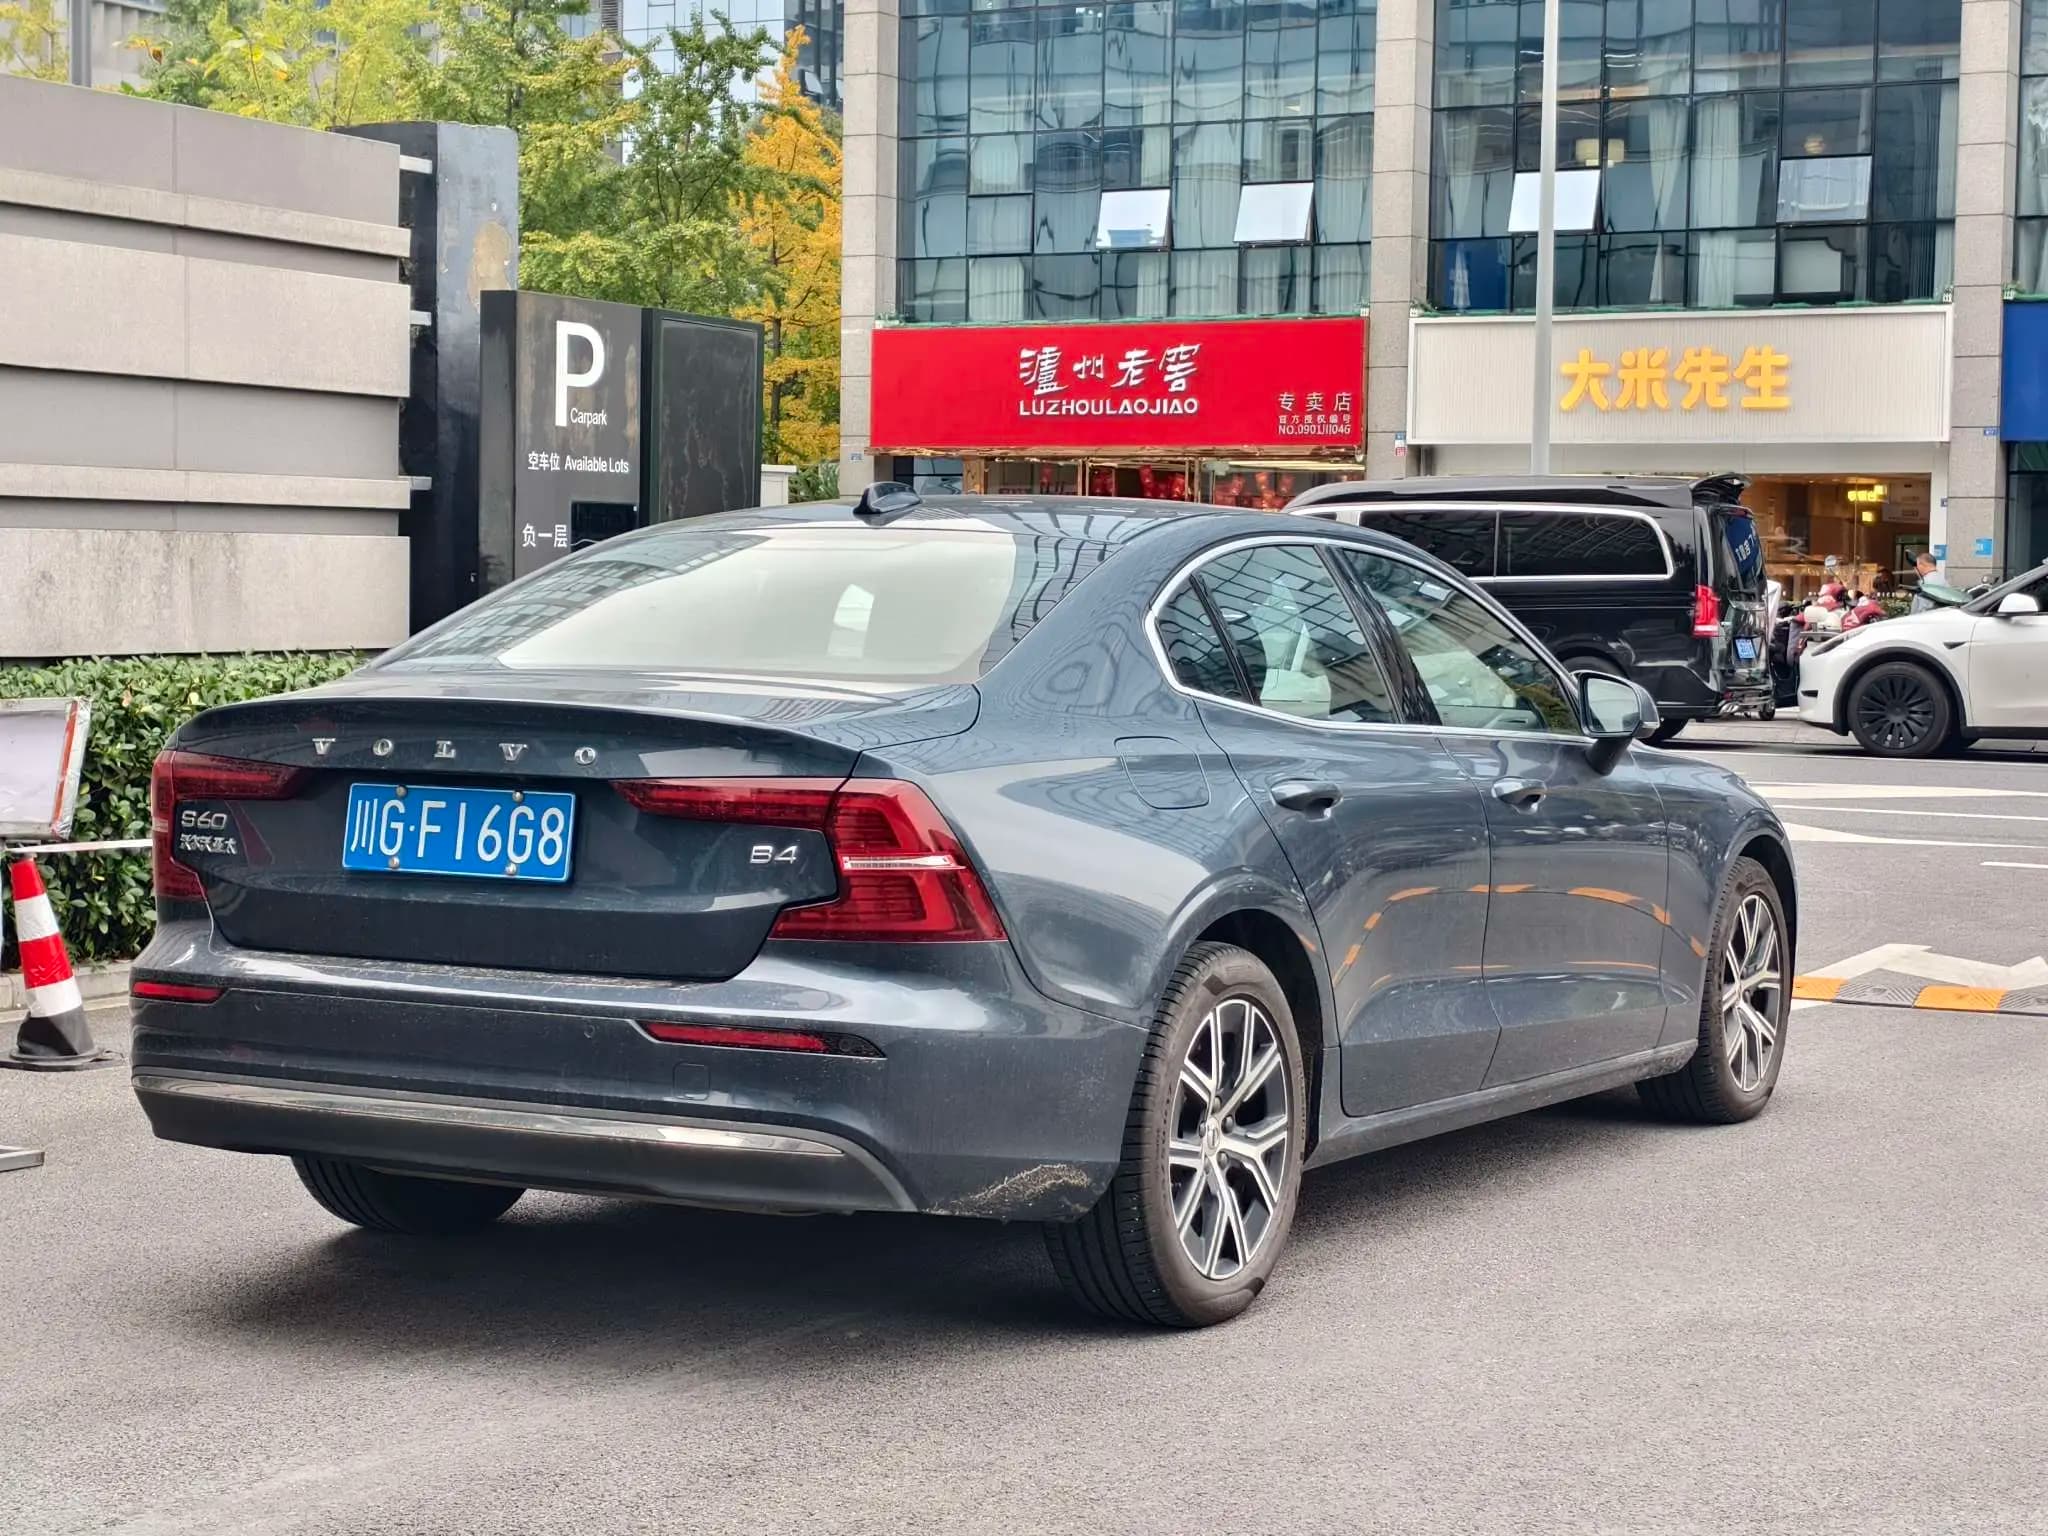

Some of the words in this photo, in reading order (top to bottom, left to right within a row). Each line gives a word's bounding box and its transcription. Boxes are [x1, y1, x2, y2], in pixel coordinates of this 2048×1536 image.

[555, 320, 605, 427] P
[1559, 345, 1791, 411] 大米先生
[1018, 398, 1198, 416] LUZHOULAOJIAO
[1278, 392, 1352, 411] 专卖店
[570, 407, 607, 427] Carpark
[527, 451, 560, 471] 空车位
[564, 455, 607, 473] Available
[609, 458, 629, 473] Lots
[522, 523, 568, 548] 负一层
[312, 737, 597, 765] VOLVO
[182, 811, 227, 829] S60
[750, 845, 798, 864] B4
